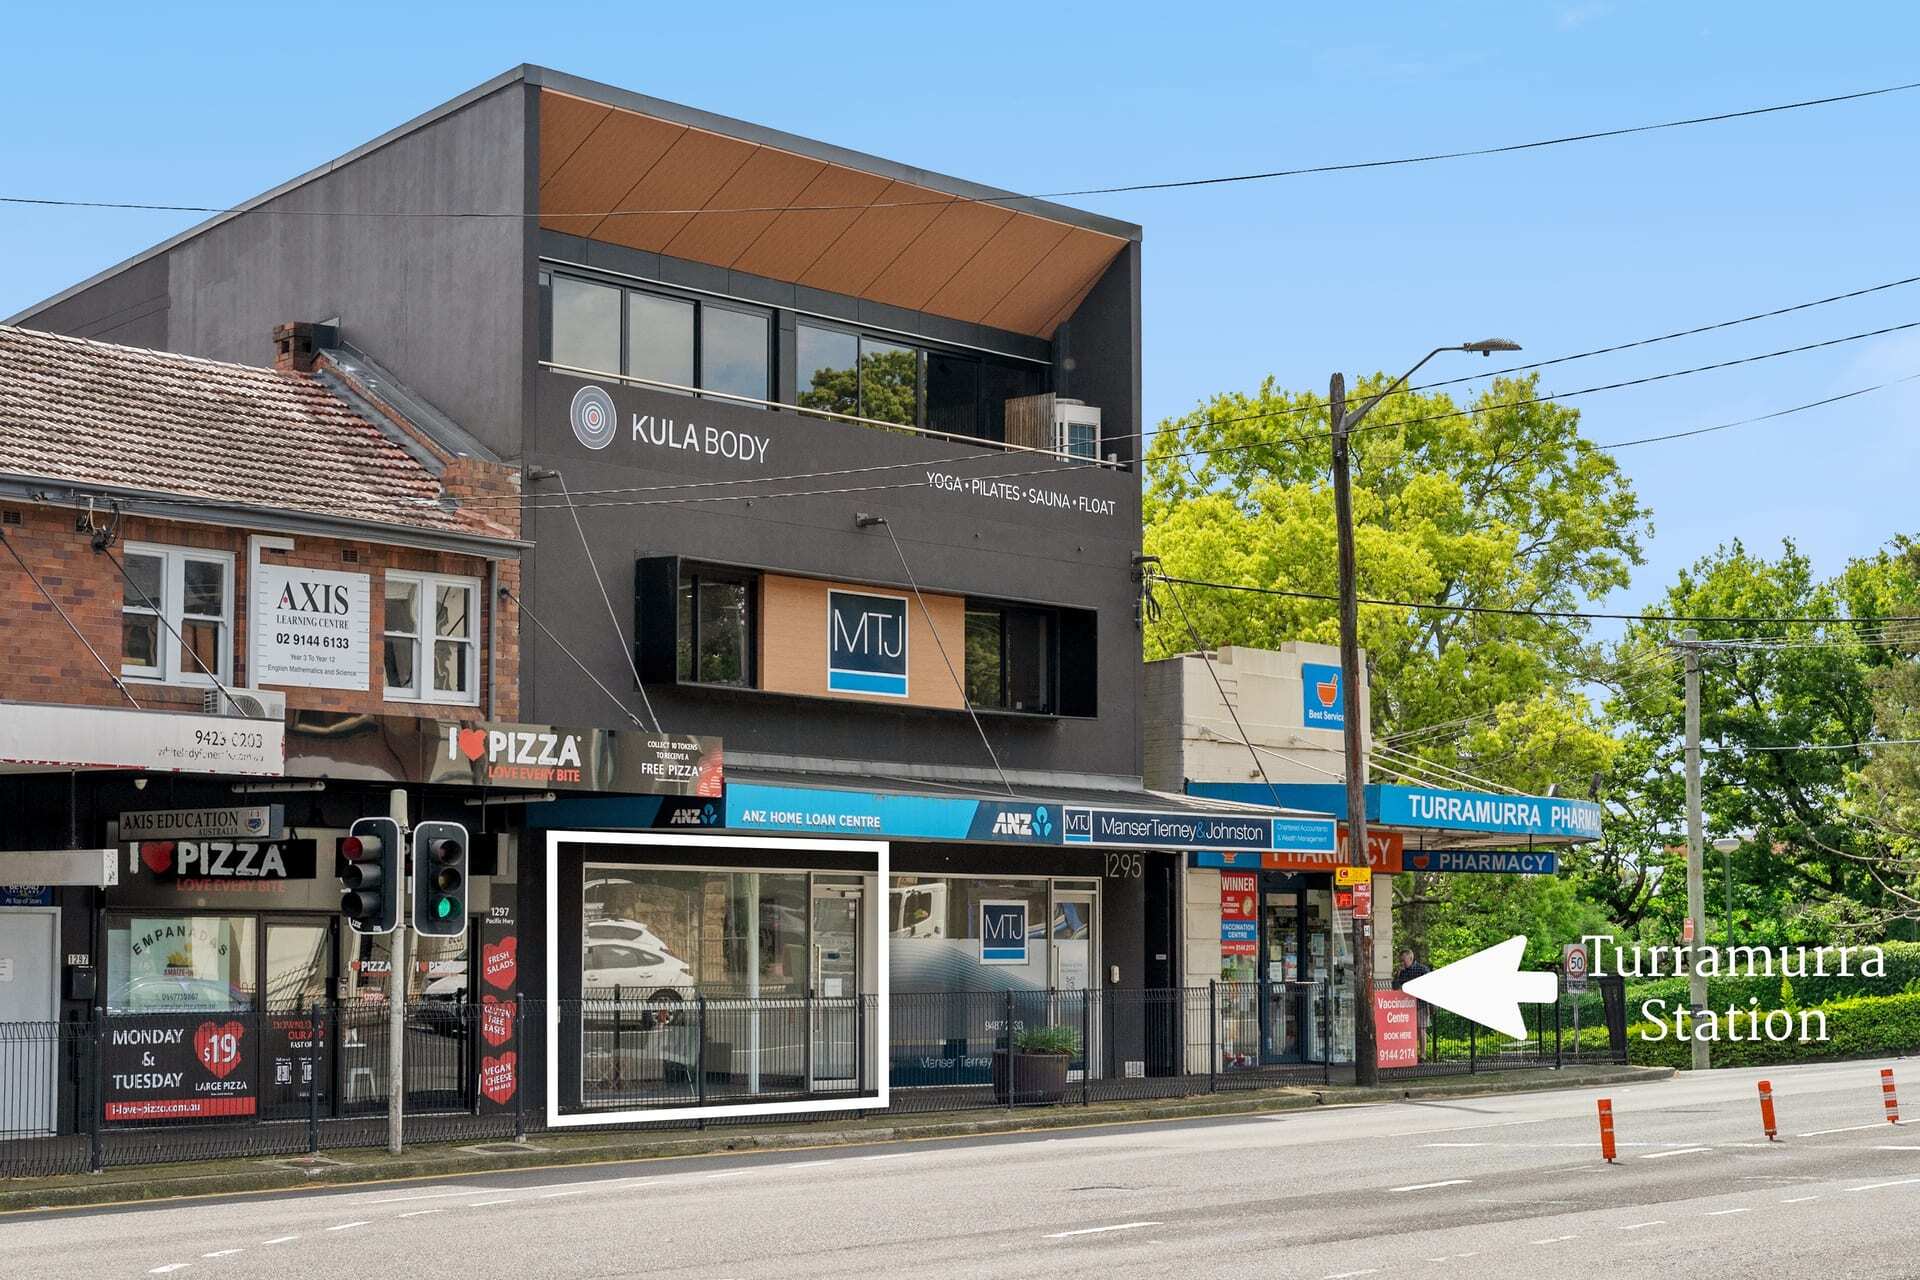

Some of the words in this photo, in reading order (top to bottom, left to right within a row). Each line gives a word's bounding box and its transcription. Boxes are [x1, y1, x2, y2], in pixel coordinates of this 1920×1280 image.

[632, 413, 700, 452] KULA
[705, 426, 770, 464] BODY
[926, 471, 962, 493] YOGA
[971, 479, 1020, 501] PILATES
[1028, 488, 1071, 509] SAUNA
[1079, 496, 1116, 516] FLOAT
[276, 580, 349, 616] AXIS
[276, 614, 317, 627] LEARNING
[318, 617, 349, 630] CENTRE
[276, 633, 290, 645] 02
[293, 634, 320, 647] 9144
[323, 637, 349, 649] 6133
[834, 609, 902, 657] MTJ
[1308, 709, 1323, 720] Best
[448, 727, 458, 761] I
[489, 731, 582, 767] PIZZA
[647, 740, 670, 749] COLLECT
[671, 742, 678, 750] 10
[678, 743, 698, 751] TOKENS
[656, 751, 664, 759] TO
[664, 752, 684, 760] RECEIVE
[488, 765, 519, 780] LOVE
[519, 766, 556, 782] EVERY
[556, 768, 581, 783] BITE
[641, 762, 665, 775] FREE
[668, 764, 699, 777] PIZZA
[670, 808, 701, 824] ANZ
[1408, 794, 1541, 827] TURRAMURRA
[123, 814, 153, 830] AXIS
[157, 811, 239, 830] EDUCATION
[742, 810, 767, 822] ANZ
[770, 811, 802, 825] HOME
[806, 813, 836, 826] LOAN
[839, 814, 880, 828] CENTRE
[992, 811, 1033, 836] ANZ
[1065, 814, 1090, 831] MTJ
[199, 828, 238, 836] AUSTRALIA
[129, 842, 139, 874] I
[177, 841, 287, 877] PIZZA
[1103, 852, 1142, 879] 1295
[1439, 852, 1547, 871] PHARMACY
[176, 878, 213, 893] LOVE
[214, 878, 259, 893] EVERY
[259, 879, 287, 893] BITE
[1221, 876, 1255, 892] WINNER
[490, 907, 510, 917] 1297
[502, 918, 514, 926] Hwy
[985, 913, 1023, 940] MTJ
[1222, 923, 1255, 931] VACCINATION
[1227, 931, 1248, 939] CENTRE
[488, 951, 510, 965] FRESH
[1571, 957, 1583, 970] 50
[361, 961, 392, 972] PIZZA
[487, 958, 514, 975] SALADS
[1377, 998, 1416, 1009] Vaccination
[1387, 1012, 1409, 1023] Centre
[112, 1028, 184, 1045] MONDAY
[288, 1031, 305, 1040] OUR
[1383, 1032, 1399, 1041] BOOK
[203, 1033, 237, 1063] $19
[1380, 1049, 1399, 1061] 9144
[1400, 1048, 1415, 1060] 2174
[141, 1051, 155, 1067] &
[920, 1055, 957, 1069] Manser
[485, 1063, 511, 1075] VEGAN
[112, 1072, 183, 1090] TUESDAY
[195, 1081, 222, 1091] LARGE
[223, 1081, 248, 1090] PIZZA
[485, 1072, 513, 1086] CHEESE
[112, 1103, 201, 1114] i-love-pizza.com.au
